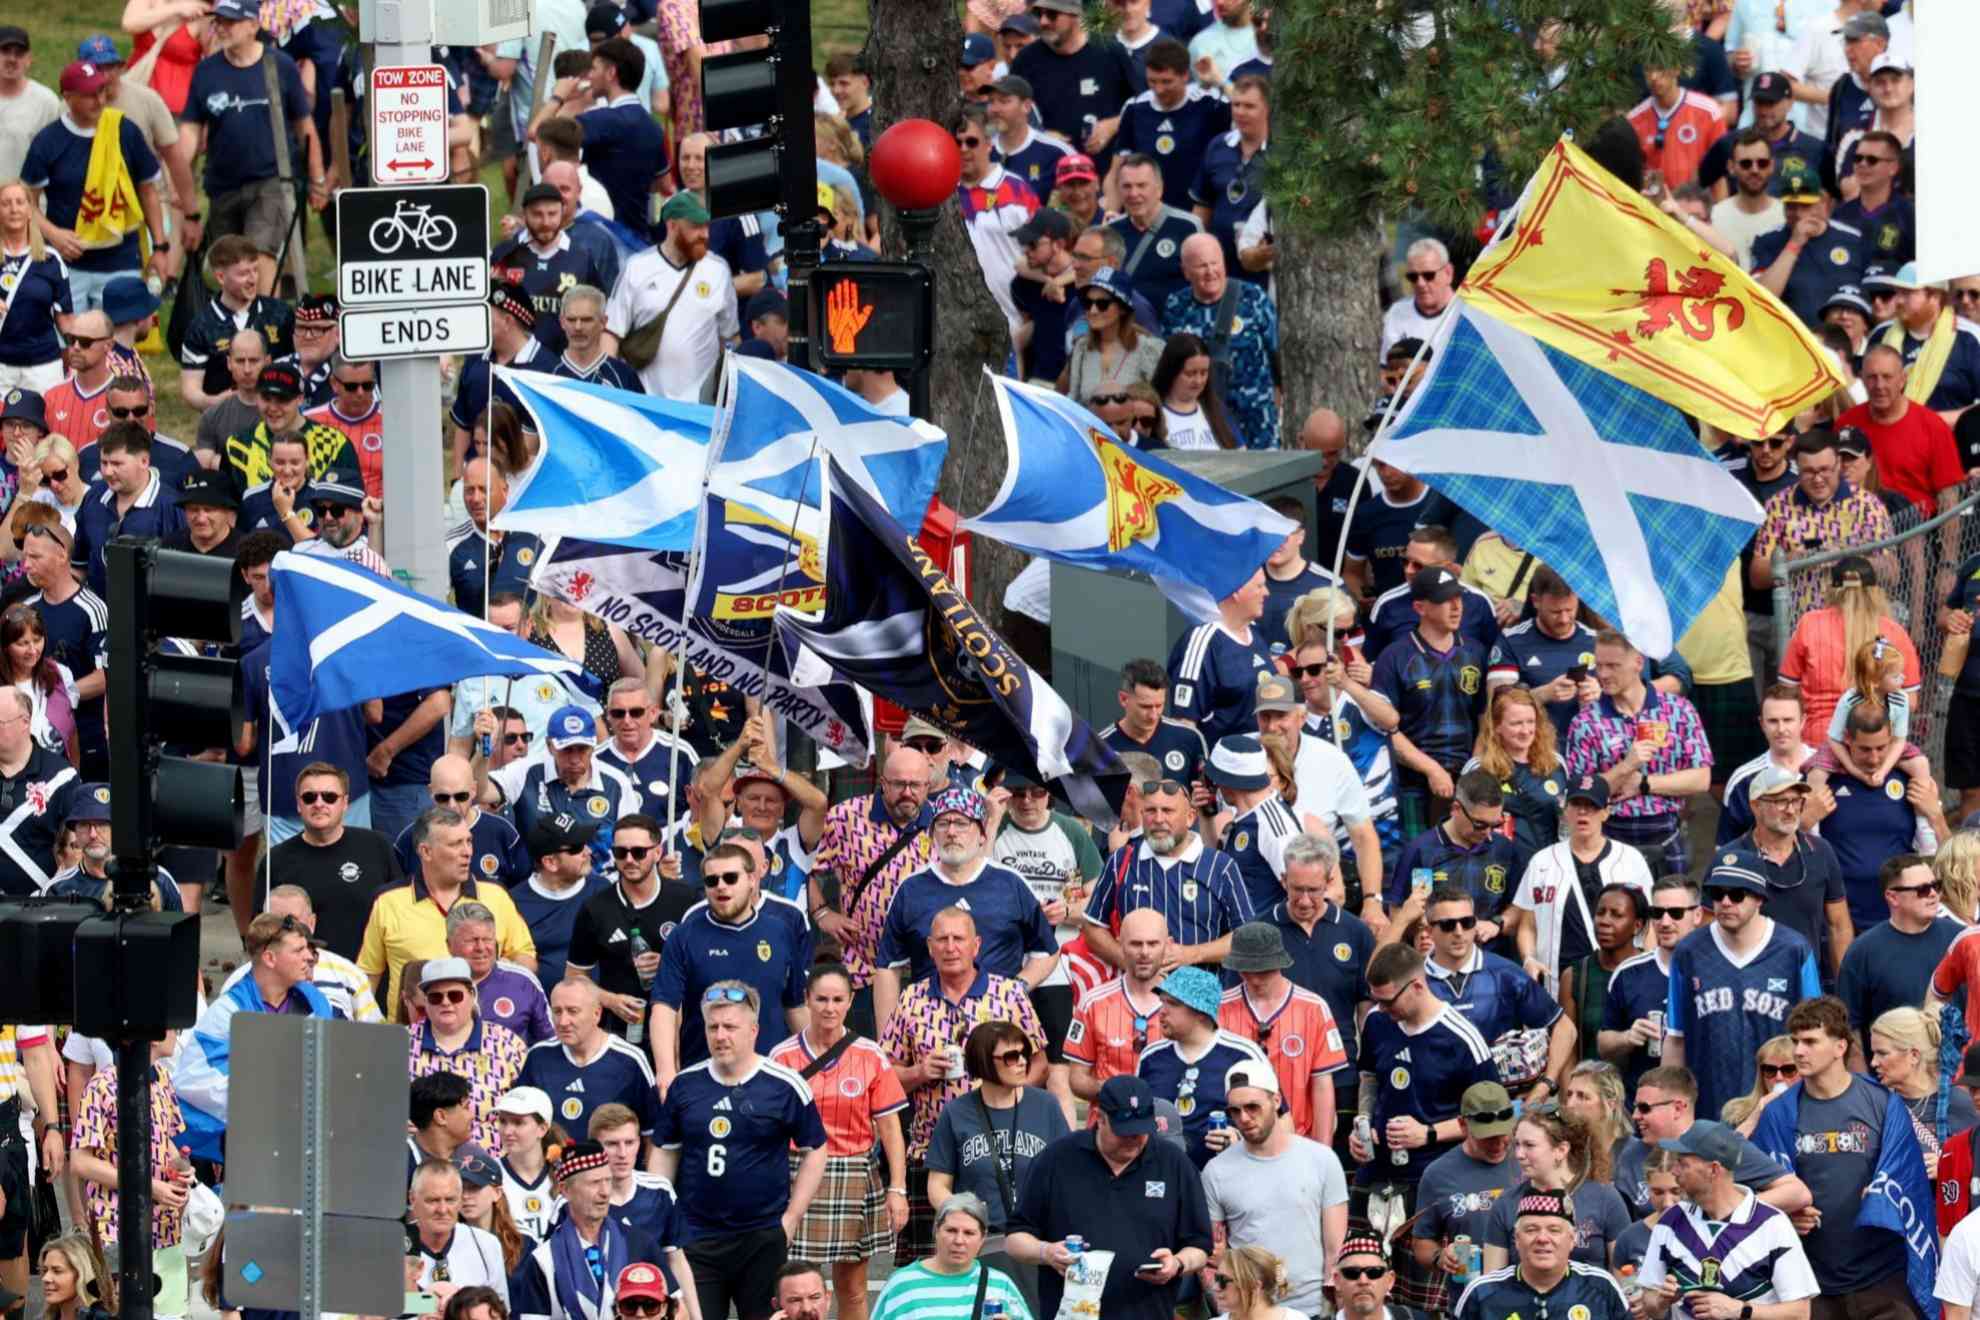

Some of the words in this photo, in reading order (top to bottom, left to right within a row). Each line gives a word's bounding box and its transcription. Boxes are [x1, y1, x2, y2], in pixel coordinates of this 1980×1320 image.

[376, 71, 404, 86] TOW
[407, 70, 443, 84] ZONE
[400, 92, 419, 105] NO
[379, 109, 441, 123] STOPPING
[397, 126, 423, 138] BIKE
[395, 141, 424, 154] LANE
[352, 267, 404, 295] BIKE
[416, 264, 477, 293] LANE
[381, 317, 450, 345] ENDS
[731, 585, 828, 613] SCOT
[595, 595, 632, 622] NO
[732, 671, 765, 696] NO
[764, 685, 826, 731] PARTY
[1694, 986, 1734, 1019] RED
[1743, 987, 1789, 1021] SOX
[707, 1143, 727, 1177] 6
